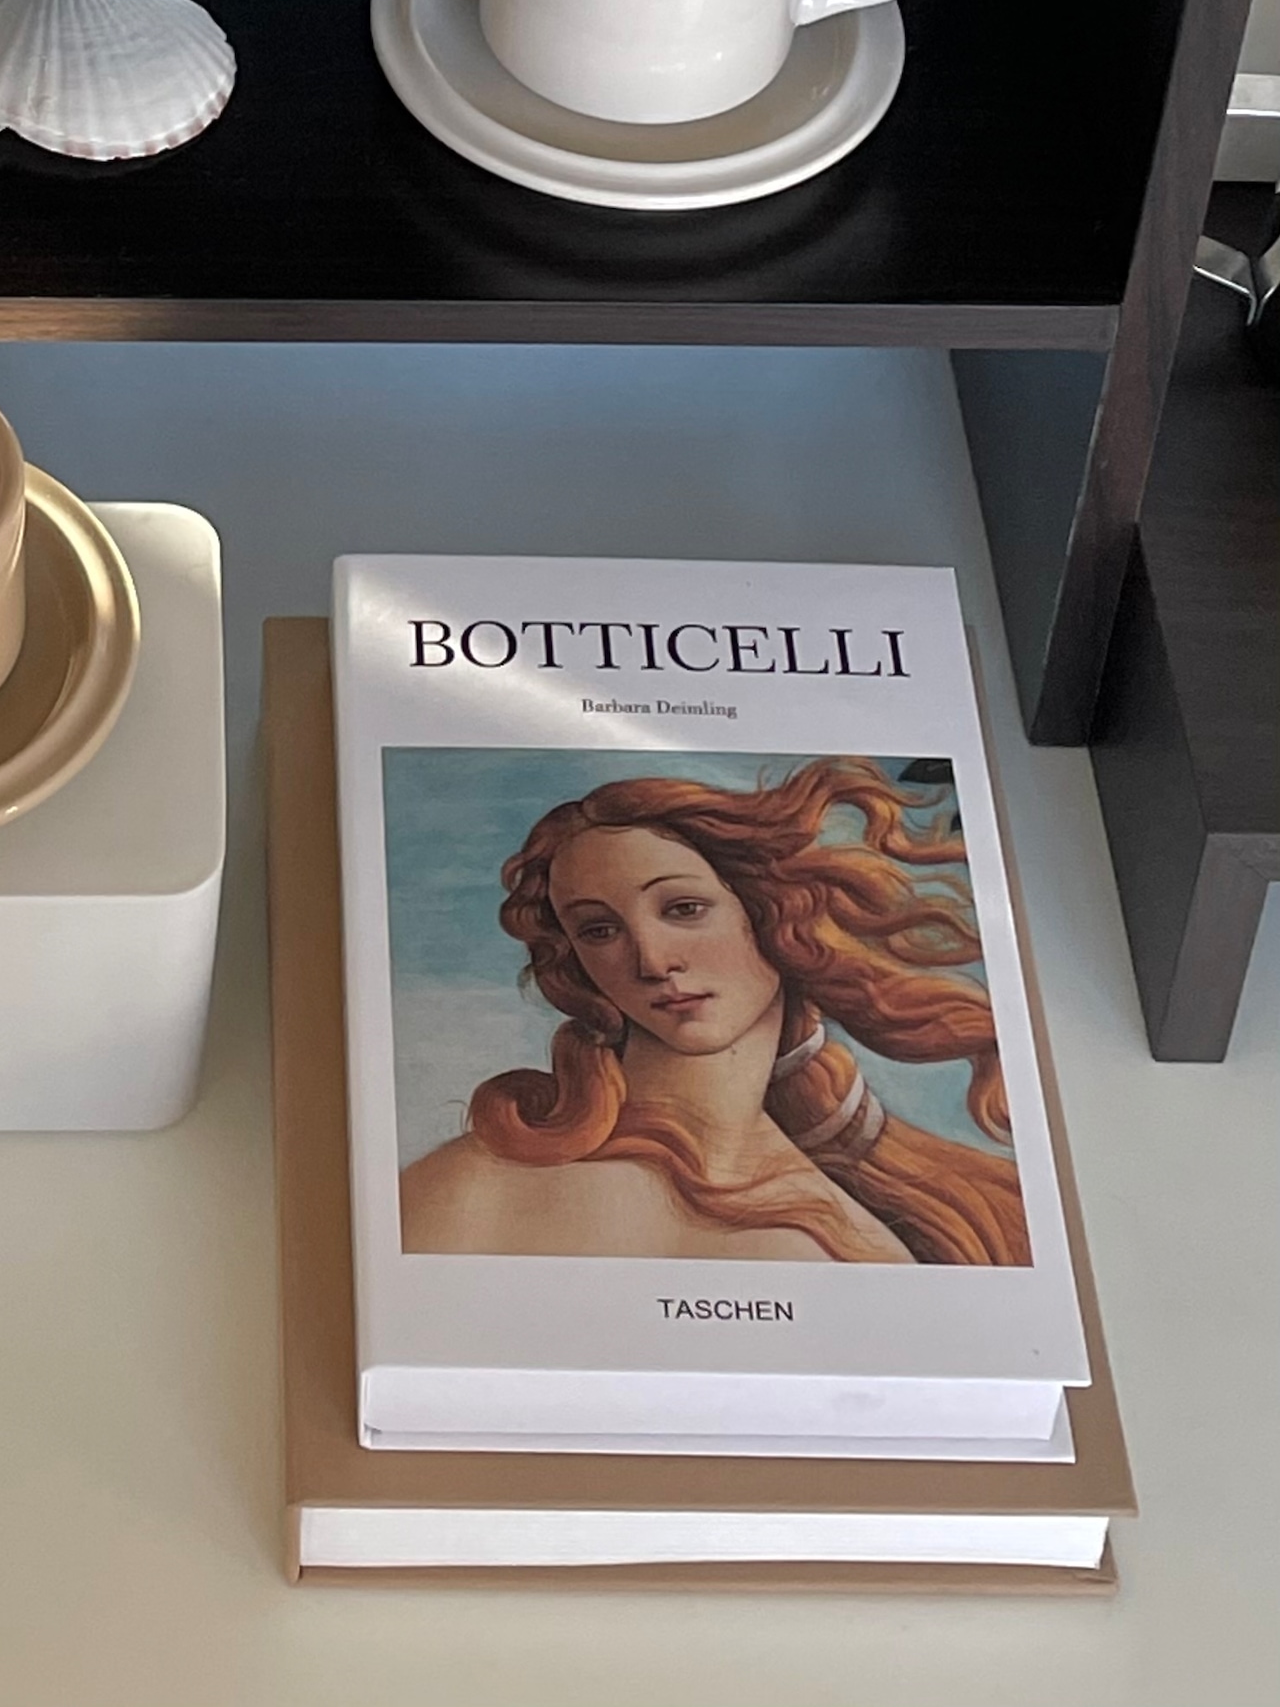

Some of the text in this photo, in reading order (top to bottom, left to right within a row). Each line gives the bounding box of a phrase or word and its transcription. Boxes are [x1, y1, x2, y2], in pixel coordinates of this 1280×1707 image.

[408, 619, 911, 679] BOTTICELLI
[581, 698, 738, 720] Barbara Deimling
[657, 1298, 794, 1322] TASCHEN
